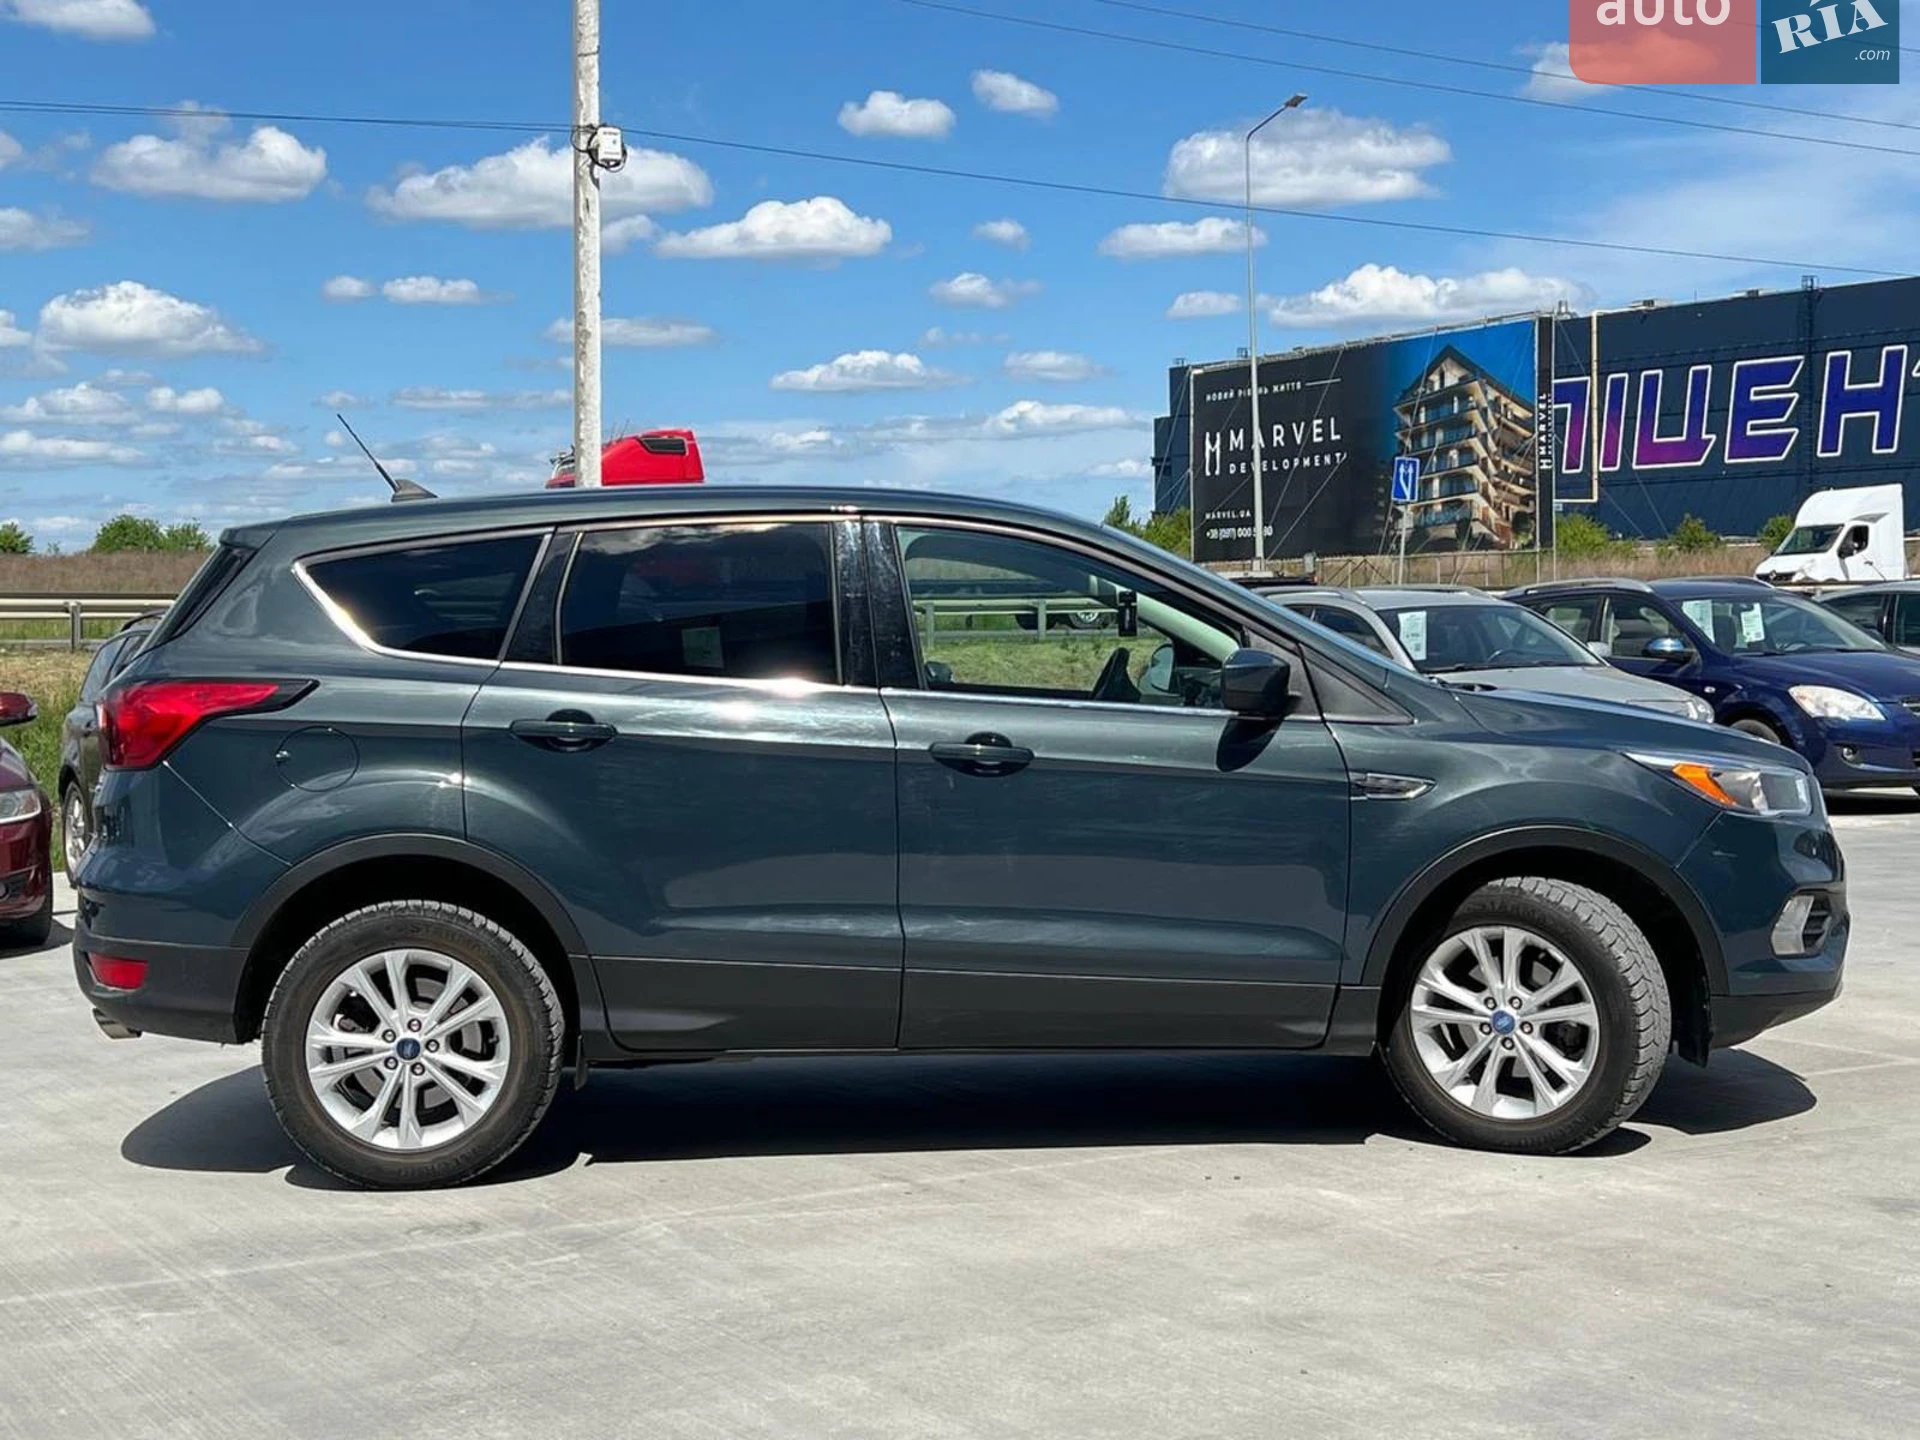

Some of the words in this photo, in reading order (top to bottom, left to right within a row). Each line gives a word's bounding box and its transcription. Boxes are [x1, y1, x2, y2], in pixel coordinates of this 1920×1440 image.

[1229, 416, 1342, 451] MARVEL
[1538, 393, 1547, 456] MARVEL
[1552, 345, 1920, 474] ПІЦЕН
